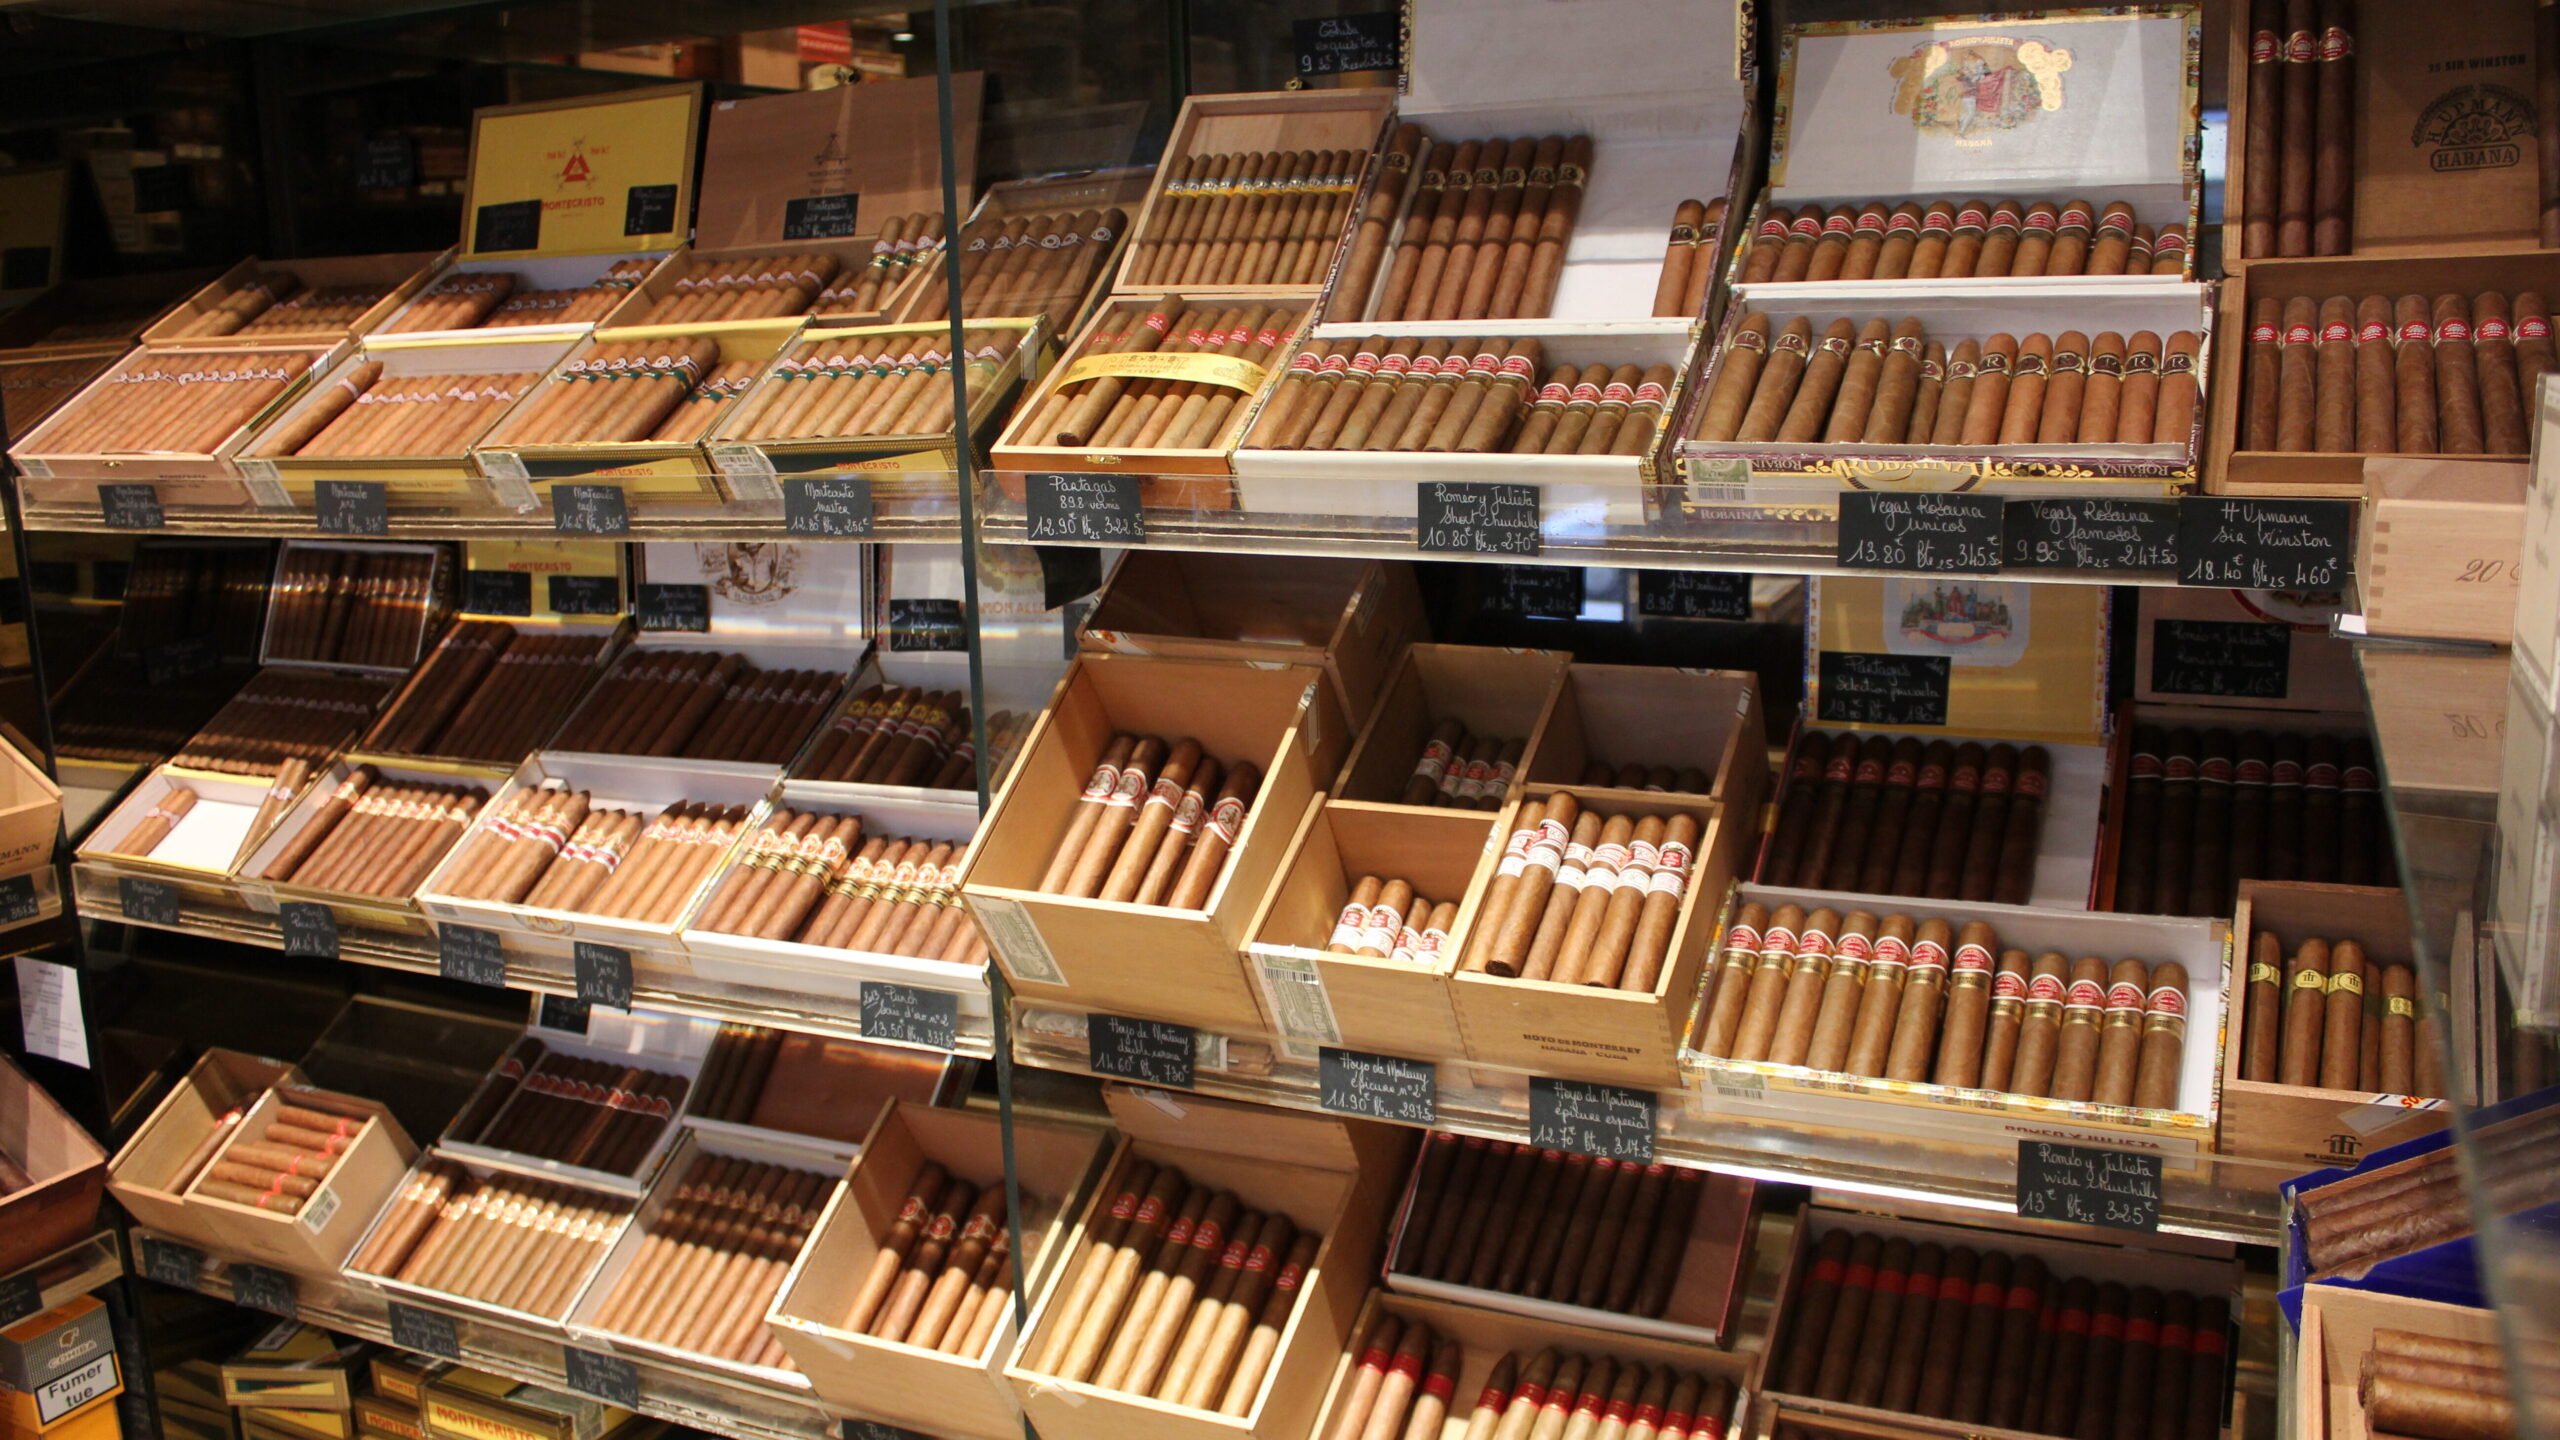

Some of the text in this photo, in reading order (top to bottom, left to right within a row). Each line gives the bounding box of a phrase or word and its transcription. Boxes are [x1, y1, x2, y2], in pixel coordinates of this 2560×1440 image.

[2469, 53, 2528, 70] WINSTON
[2437, 147, 2515, 169] HABANA
[541, 196, 605, 212] MONTECRISTO
[1752, 459, 1802, 473] ROBAIN
[2099, 463, 2169, 477] ROBAINA
[1700, 507, 1764, 521] ROBAINA
[1869, 493, 1987, 532] Vegas Robaina
[2030, 500, 2155, 534] Vegas Robaina
[2243, 503, 2314, 534] Upmann
[2258, 528, 2333, 548] Winston
[2455, 558, 2505, 583] 20
[48, 1362, 103, 1399] Fumer
[65, 1386, 94, 1408] tue
